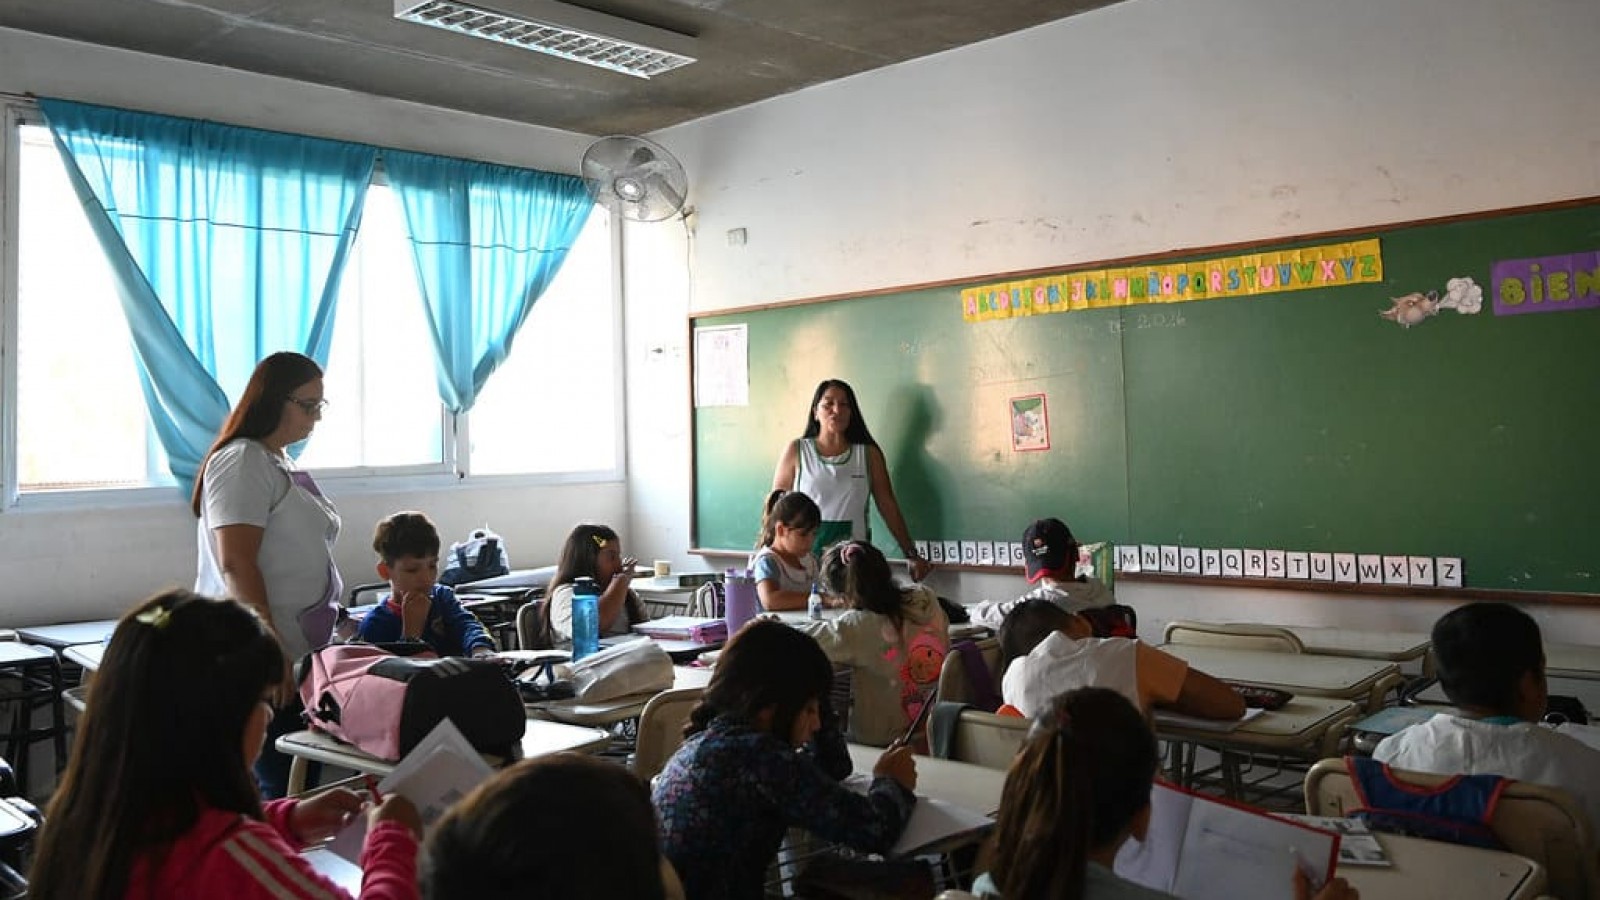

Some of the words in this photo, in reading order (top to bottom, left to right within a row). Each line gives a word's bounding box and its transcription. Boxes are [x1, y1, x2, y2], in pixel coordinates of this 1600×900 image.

[933, 547, 942, 559] B
[948, 547, 958, 559] C
[965, 547, 975, 560] D
[982, 548, 991, 560] E
[999, 547, 1007, 559] F
[1014, 548, 1023, 560] G
[1123, 553, 1135, 565] M
[1145, 552, 1156, 565] N
[1184, 555, 1196, 570] O
[1207, 555, 1216, 569] P
[1226, 555, 1239, 571] Q
[1251, 555, 1262, 569] R
[1271, 557, 1281, 572] S
[1293, 558, 1304, 573] T
[1314, 558, 1326, 573] U
[1338, 562, 1351, 576] V
[1360, 564, 1379, 579] W
[1391, 562, 1403, 578] X
[1416, 563, 1428, 579] Y
[1443, 564, 1456, 580] Z
